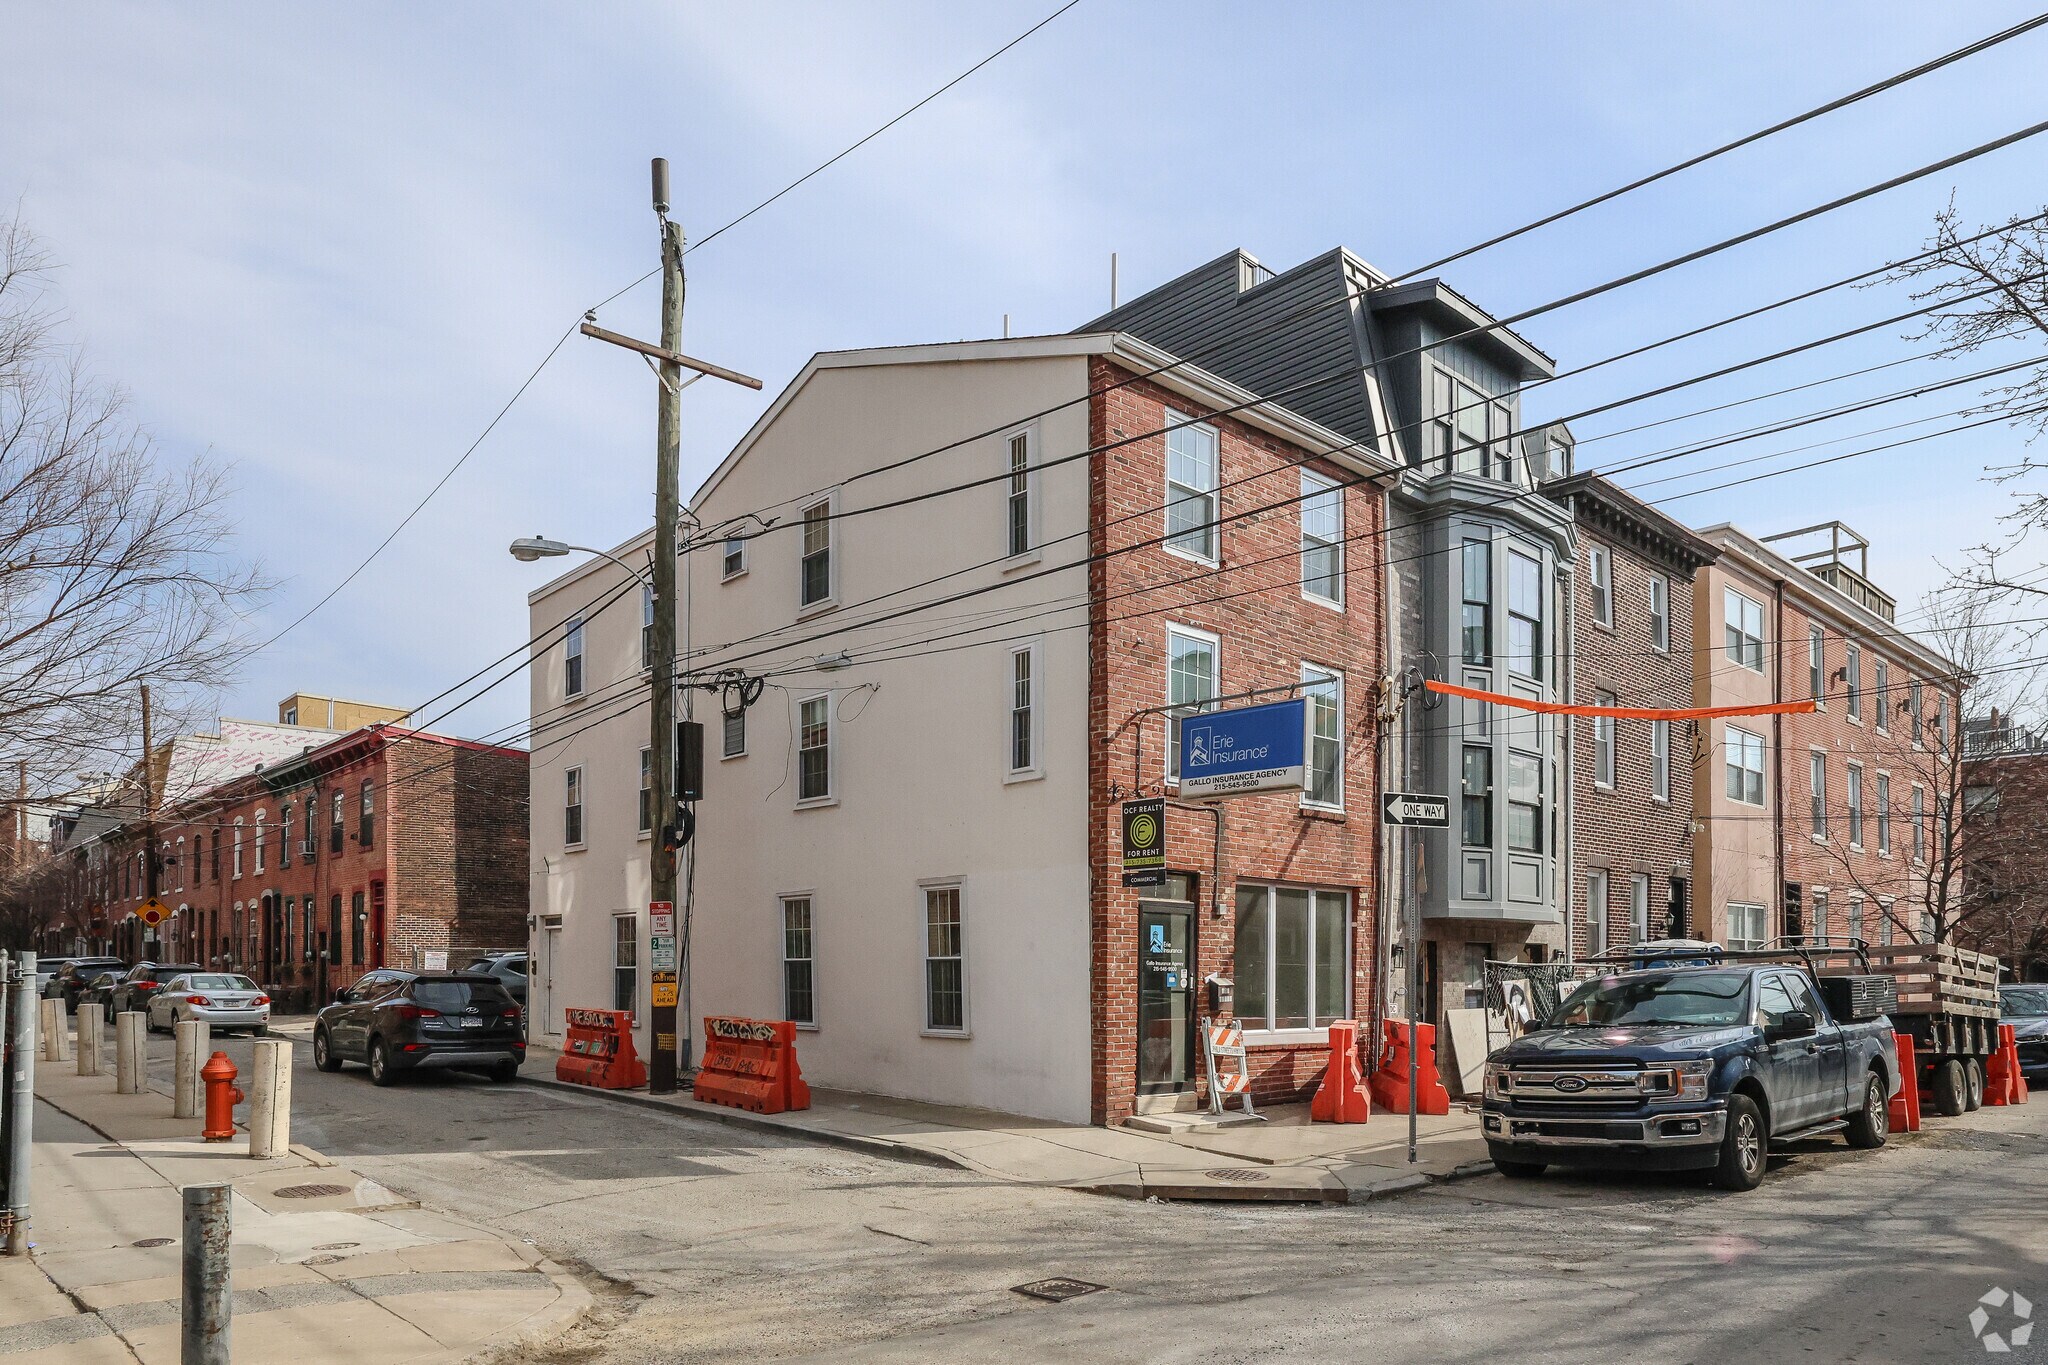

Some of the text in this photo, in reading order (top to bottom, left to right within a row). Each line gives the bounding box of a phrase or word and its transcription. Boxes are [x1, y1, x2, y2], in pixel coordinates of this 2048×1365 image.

[1212, 734, 1234, 749] Erie
[1212, 746, 1268, 763] Insurance
[1188, 768, 1288, 786] GALLO INSURANCE AGENCY
[1213, 779, 1259, 790] 215-545-9500
[1123, 804, 1163, 815] OCF REALTY
[1403, 803, 1442, 817] ONE WAY
[1142, 848, 1160, 856] RENT
[652, 939, 658, 948] 2
